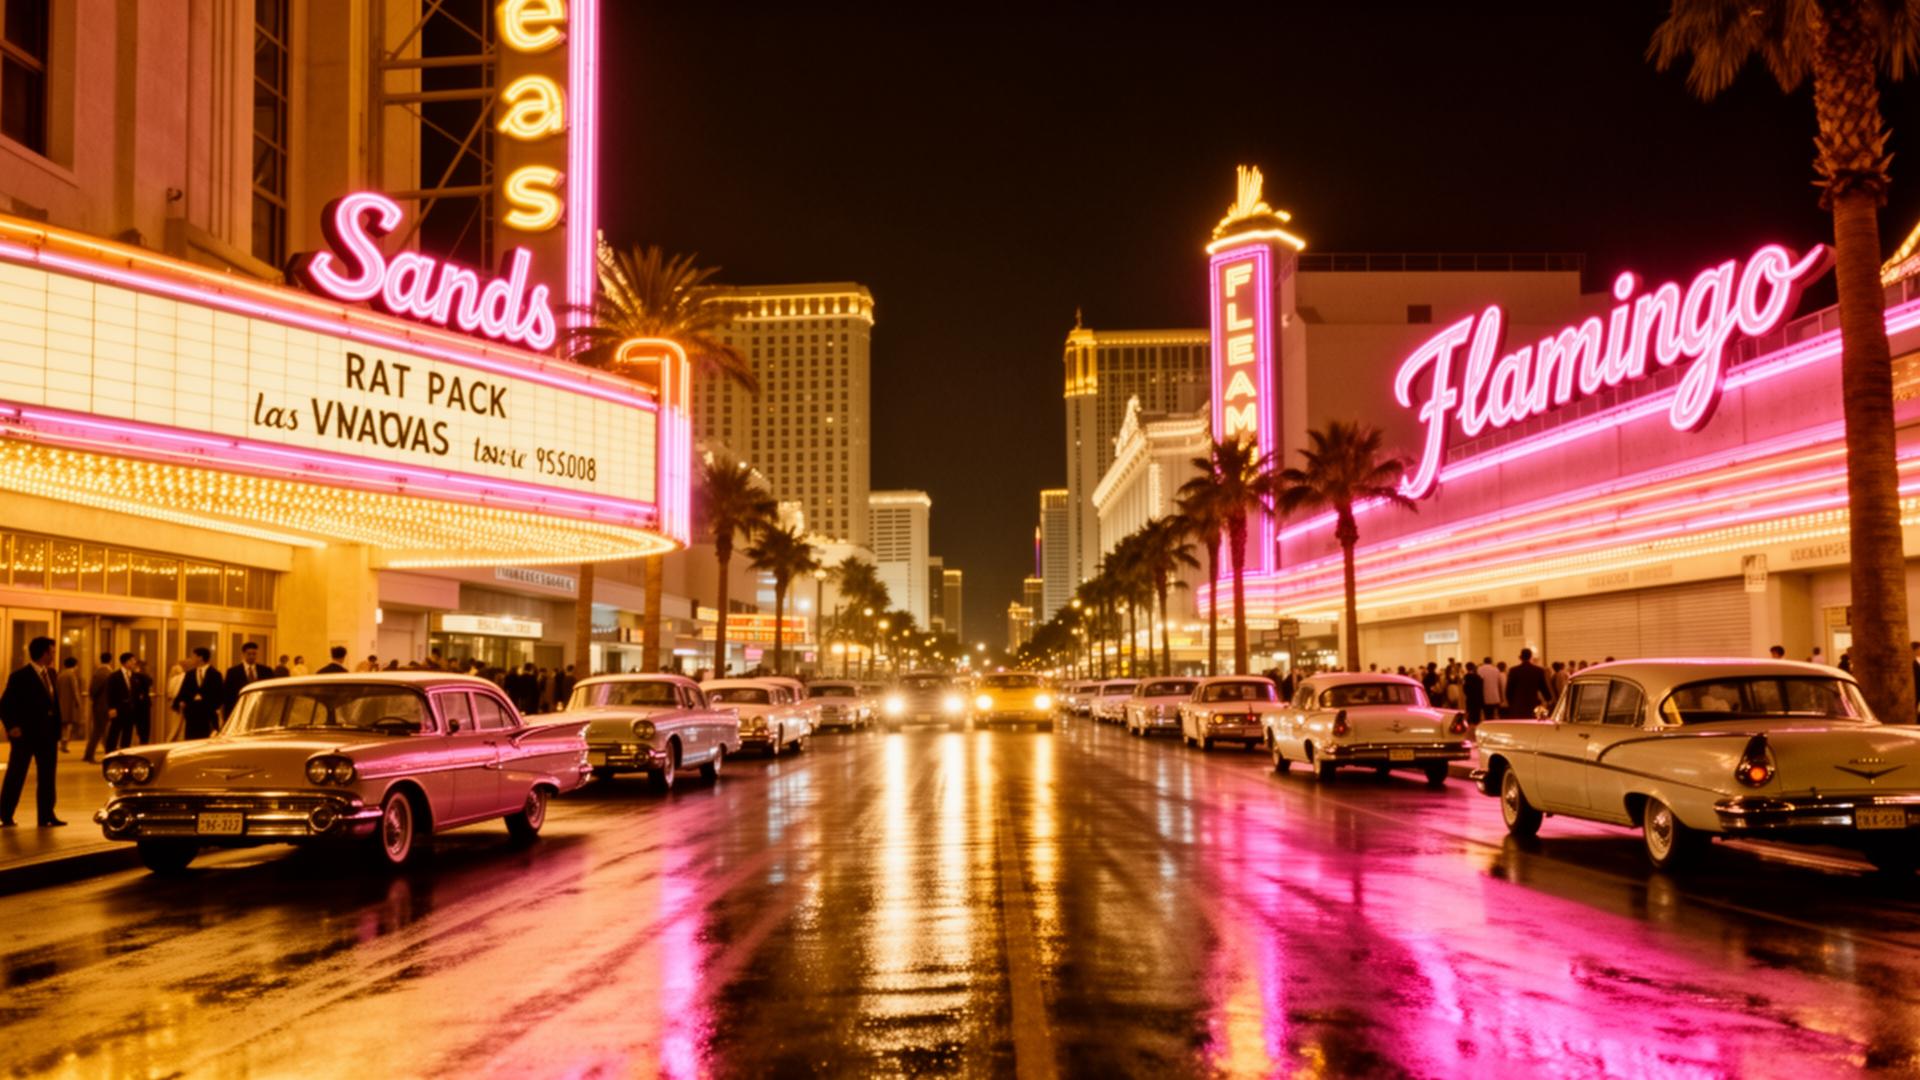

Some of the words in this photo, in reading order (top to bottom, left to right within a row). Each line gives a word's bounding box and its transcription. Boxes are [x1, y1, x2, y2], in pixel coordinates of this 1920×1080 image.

[308, 191, 558, 351] Sands
[253, 392, 300, 431] las
[345, 352, 411, 399] RAT
[428, 371, 508, 419] PACK
[1394, 243, 1834, 500] Flamingo
